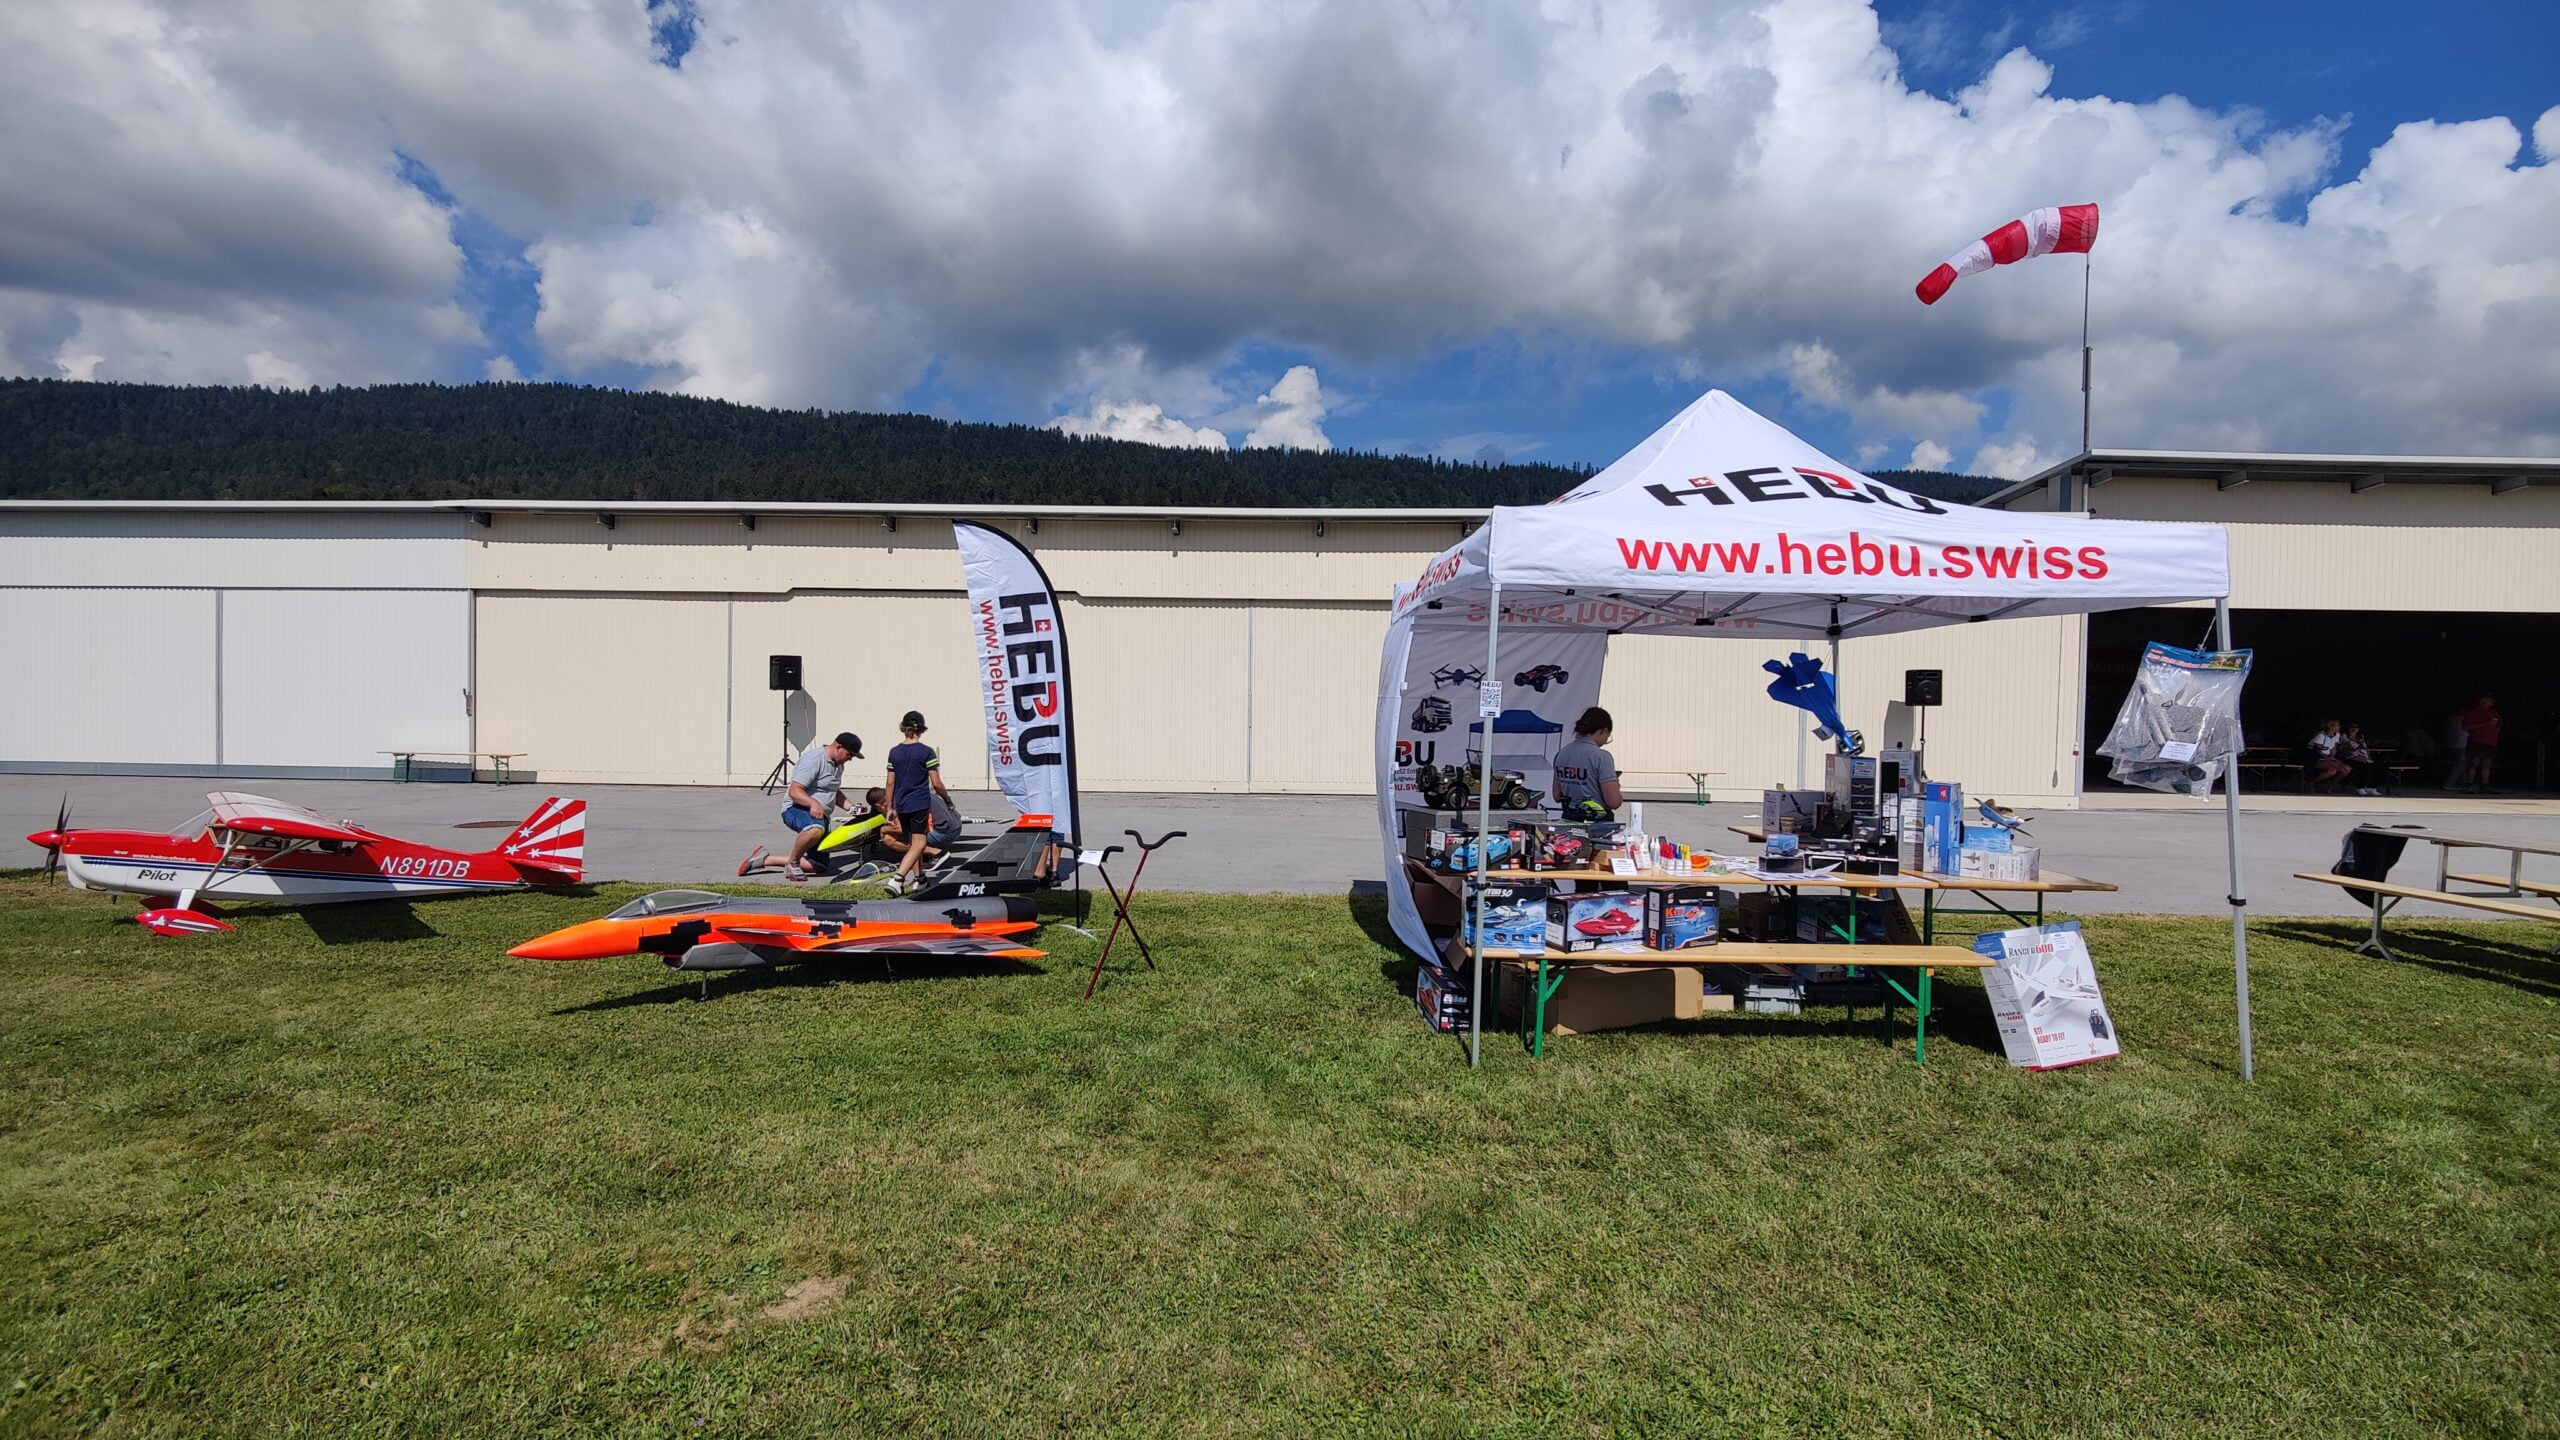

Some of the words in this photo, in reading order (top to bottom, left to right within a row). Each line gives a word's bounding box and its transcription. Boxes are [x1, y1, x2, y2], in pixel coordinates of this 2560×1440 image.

[1643, 467, 1948, 515] HEBU
[1616, 531, 2109, 580] www.hebu.swiss
[979, 599, 1013, 767] www.hebu.swiss
[998, 591, 1062, 767] HEBU
[1555, 766, 1588, 780] HEBU
[137, 869, 177, 881] Pilot
[380, 856, 470, 877] N891DB
[958, 883, 985, 896] Pilot
